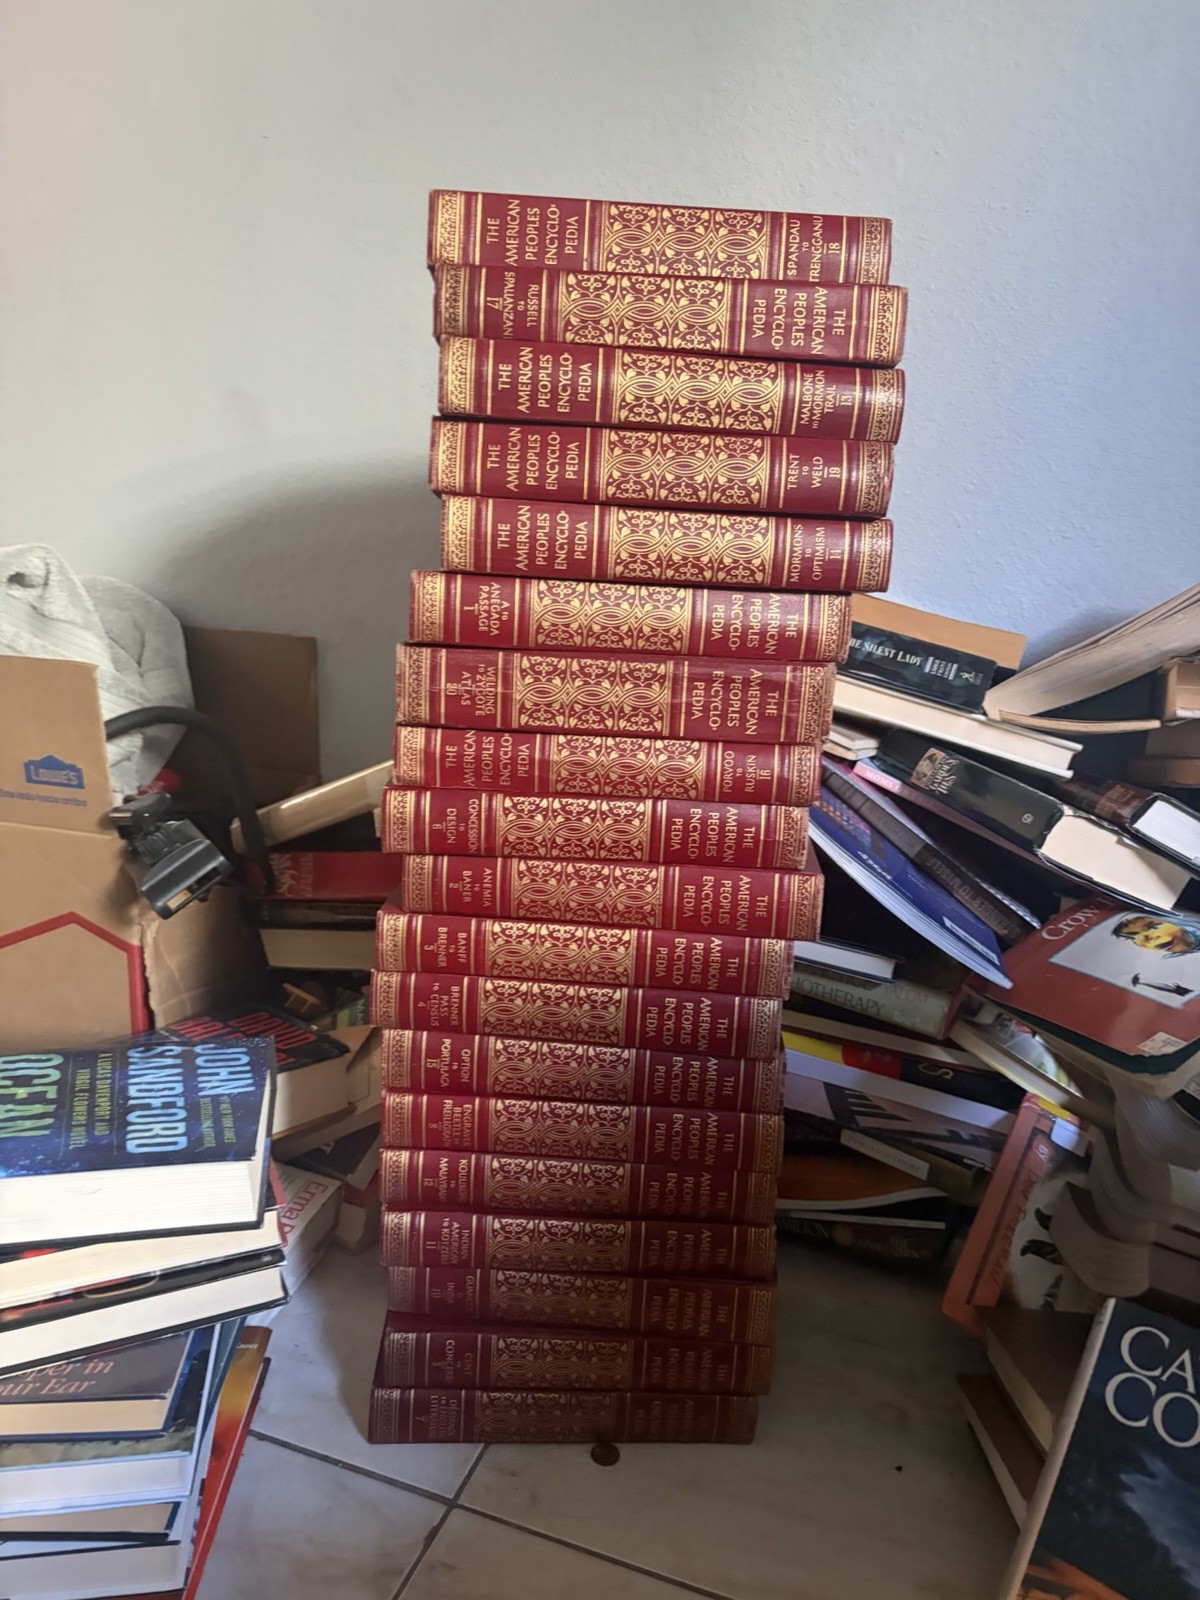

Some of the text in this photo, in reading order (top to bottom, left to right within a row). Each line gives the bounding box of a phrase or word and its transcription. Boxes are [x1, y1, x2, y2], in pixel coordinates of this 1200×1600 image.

[486, 218, 500, 244] THE
[505, 200, 521, 266] AMERICAN
[525, 207, 540, 260] PEOPLES
[565, 216, 579, 254] PEDIA
[787, 220, 800, 276] SPANDAU
[828, 242, 840, 254] 18
[487, 297, 500, 310] 17
[527, 284, 539, 327] RUSSELL
[752, 300, 766, 338] PEDIA
[791, 293, 807, 347] PEOPLES
[811, 287, 828, 354] AMERICAN
[832, 309, 846, 336] THE
[498, 363, 512, 390] THE
[517, 347, 533, 413] AMERICAN
[538, 354, 553, 408] PEOPLES
[578, 363, 592, 401] PEDIA
[800, 372, 813, 424] MALBONE
[814, 370, 825, 423] MORMON
[824, 385, 836, 413] TRAIL
[840, 395, 852, 406] 13
[487, 445, 500, 469] THE
[506, 427, 521, 491] AMERICAN
[526, 435, 541, 485] PEOPLES
[565, 442, 580, 479] PEDIA
[787, 454, 800, 489] TRENT
[811, 456, 823, 488] WELD
[829, 467, 840, 478] 19
[497, 523, 510, 550] THE
[515, 505, 531, 571] AMERICAN
[536, 513, 549, 565] PEOPLES
[574, 522, 588, 559] PEDIA
[790, 524, 803, 583] MORMONS
[812, 527, 826, 580] OPTIMISM
[830, 549, 842, 559] 14
[479, 585, 489, 632] PASSAGE
[490, 582, 501, 636] ANEGADA
[499, 601, 510, 609] A
[711, 605, 724, 640] PEDIA
[747, 599, 761, 648] PEOPLES
[764, 594, 781, 655] AMERICAN
[785, 614, 798, 638] THE
[850, 638, 861, 650] HE
[897, 651, 923, 667] LADY
[446, 683, 457, 696] 20
[461, 671, 471, 706] ATLAS
[476, 675, 486, 716] ZYGOTE
[486, 666, 496, 715] WELDING
[691, 682, 705, 719] PEDIA
[727, 675, 742, 727] PEOPLES
[745, 668, 763, 735] AMERICAN
[765, 691, 778, 717] THE
[30, 765, 78, 785] LOWE'S
[446, 745, 457, 768] THE
[464, 730, 476, 787] AMERICAN
[482, 736, 495, 782] PEOPLES
[517, 744, 530, 776] PEDIA
[723, 751, 735, 792] PORVOO
[745, 755, 757, 792] RUSKIN
[760, 769, 771, 780] 16
[447, 808, 457, 844] DESIGN
[468, 799, 479, 854] CONCESSION
[670, 818, 683, 850] PEDIA
[706, 812, 720, 857] PEOPLES
[723, 806, 739, 863] AMERICAN
[742, 826, 756, 849] THE
[483, 868, 492, 907] ANEMIA
[683, 885, 696, 917] PEDIA
[719, 880, 732, 924] PEOPLES
[736, 875, 752, 931] AMERICAN
[756, 895, 768, 917] THE
[1042, 904, 1100, 940] Crow
[438, 927, 448, 968] BRENNER
[458, 933, 467, 963] BANFF
[655, 947, 668, 978] PEDIA
[690, 942, 704, 984] PEOPLES
[708, 937, 723, 990] AMERICAN
[726, 957, 739, 978] THE
[431, 994, 439, 1027] CENSUS
[440, 996, 449, 1017] PASS
[450, 986, 460, 1026] BRENNER
[646, 1007, 658, 1037] PEDIA
[680, 1002, 694, 1045] PEOPLES
[698, 998, 712, 1052] AMERICAN
[717, 1018, 728, 1039] THE
[74, 1069, 91, 1091] VIRGIL
[97, 1058, 112, 1078] LUCAS
[194, 1044, 256, 1096] JOHN
[441, 1039, 452, 1088] PORTULACA
[461, 1049, 471, 1082] OPTION
[654, 1066, 666, 1095] PEDIA
[687, 1061, 700, 1102] PEOPLES
[94, 1080, 112, 1120] DAVENPORT
[126, 1046, 188, 1154] SANDFORD
[705, 1057, 718, 1108] AMERICAN
[723, 1076, 734, 1096] THE
[72, 1092, 90, 1125] FLOWERS
[453, 1107, 461, 1138] BEETLE
[654, 1123, 666, 1153] PEDIA
[687, 1118, 701, 1160] PEOPLES
[705, 1112, 718, 1165] AMERICAN
[723, 1132, 735, 1153] THE
[279, 1181, 328, 1225] Emma
[83, 1359, 114, 1375] in
[1120, 1326, 1200, 1394] CA
[39, 1378, 96, 1395] Ear
